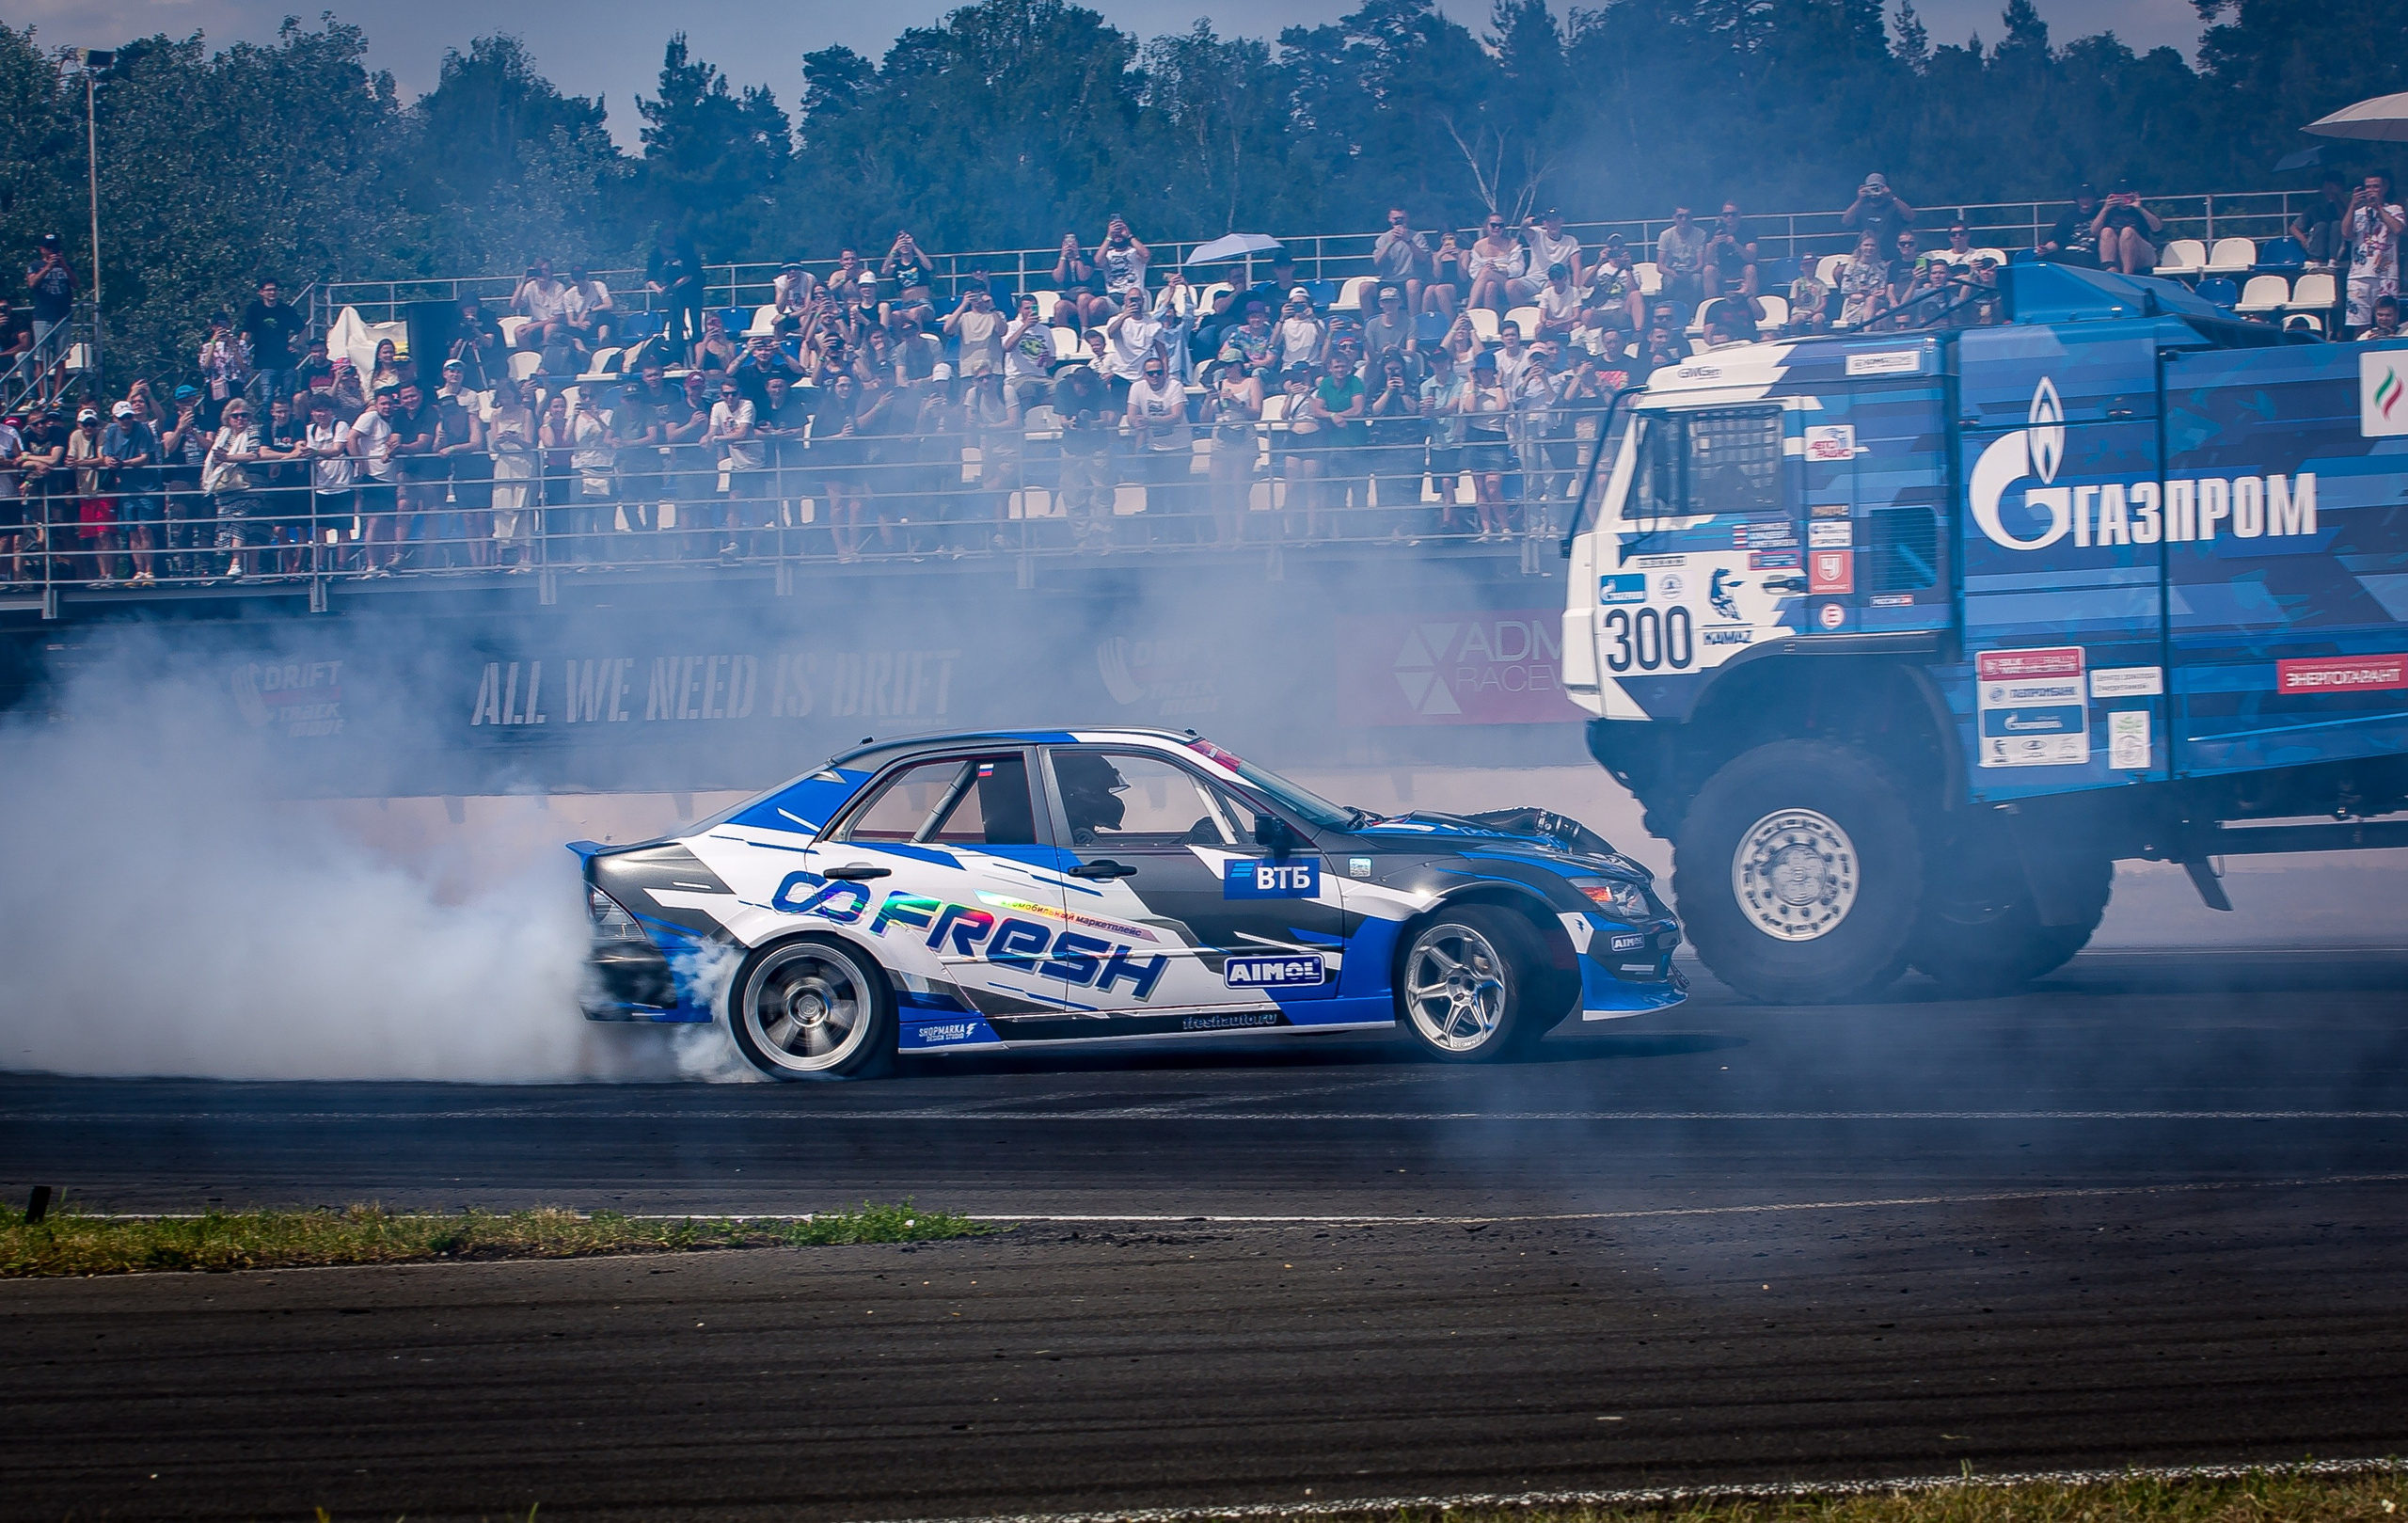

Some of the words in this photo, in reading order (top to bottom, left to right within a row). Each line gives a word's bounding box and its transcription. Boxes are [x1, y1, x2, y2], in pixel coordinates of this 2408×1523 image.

[2073, 472, 2318, 547] ГАЗПРОМ
[1605, 605, 1691, 672] 300
[263, 660, 344, 691] DRIFT
[470, 660, 547, 727] ALL
[565, 658, 636, 723] WE
[645, 655, 756, 722] NEED
[770, 652, 819, 719] IS
[832, 648, 964, 717] DRIFT
[1456, 664, 1563, 692] RACE
[1257, 865, 1311, 890] ВТБ
[997, 899, 1075, 921] омобильный
[1075, 915, 1143, 937] маркетплейс
[1228, 961, 1321, 982] AIMOL
[918, 1023, 965, 1038] SHOPMARKA
[1182, 1013, 1277, 1030] freshauto.ru
